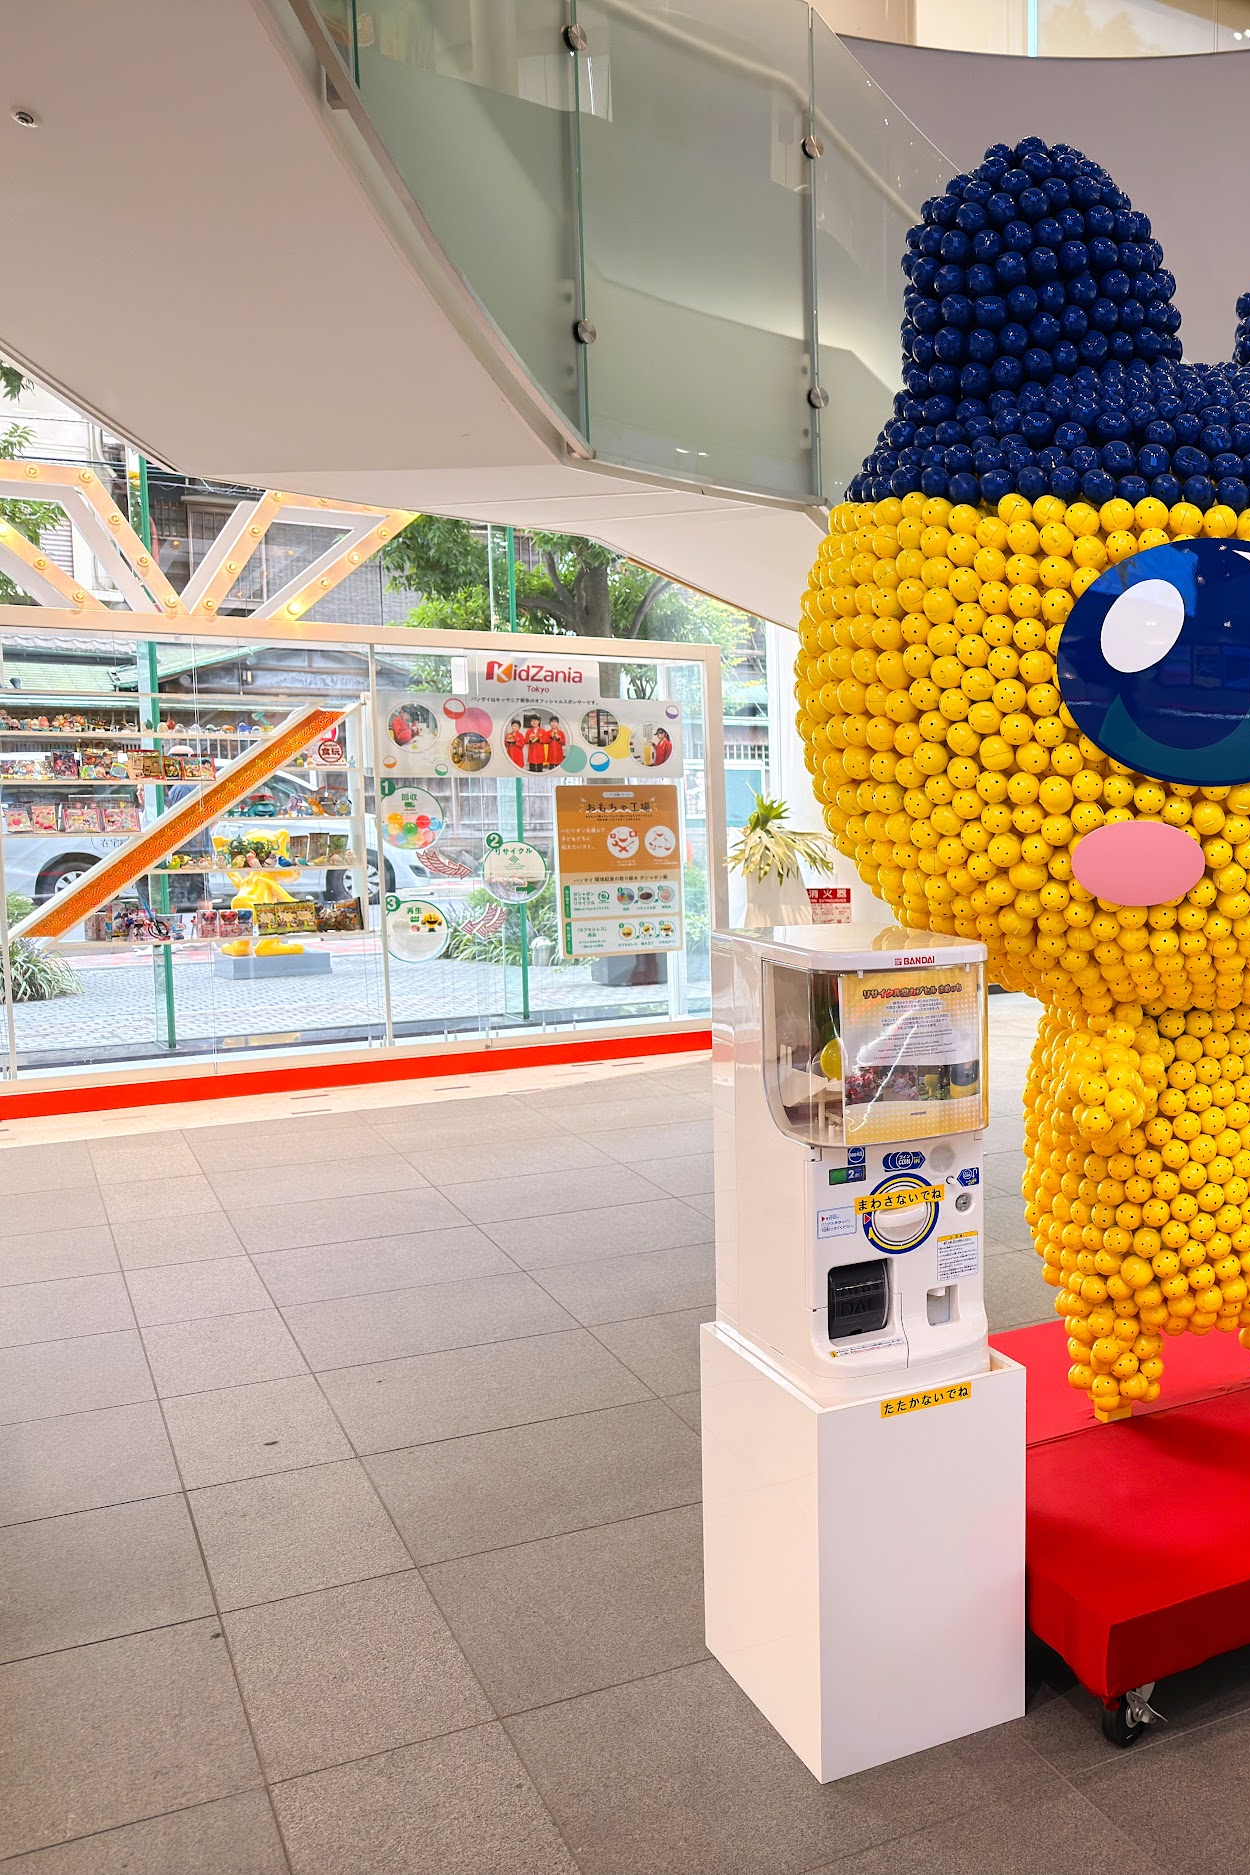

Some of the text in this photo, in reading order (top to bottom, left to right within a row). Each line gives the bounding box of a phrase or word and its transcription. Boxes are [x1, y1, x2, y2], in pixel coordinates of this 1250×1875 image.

[486, 661, 583, 683] KidZania
[527, 686, 549, 694] Tokyo
[382, 780, 389, 794] 1
[402, 793, 418, 801] 回収
[586, 802, 651, 812] おもちゃ工場
[490, 834, 500, 847] 2
[808, 890, 847, 898] 消火器
[387, 896, 397, 910] 3
[904, 956, 935, 965] BANDAI
[858, 1188, 942, 1211] まわさないでね
[884, 1386, 968, 1415] たたかないでね
